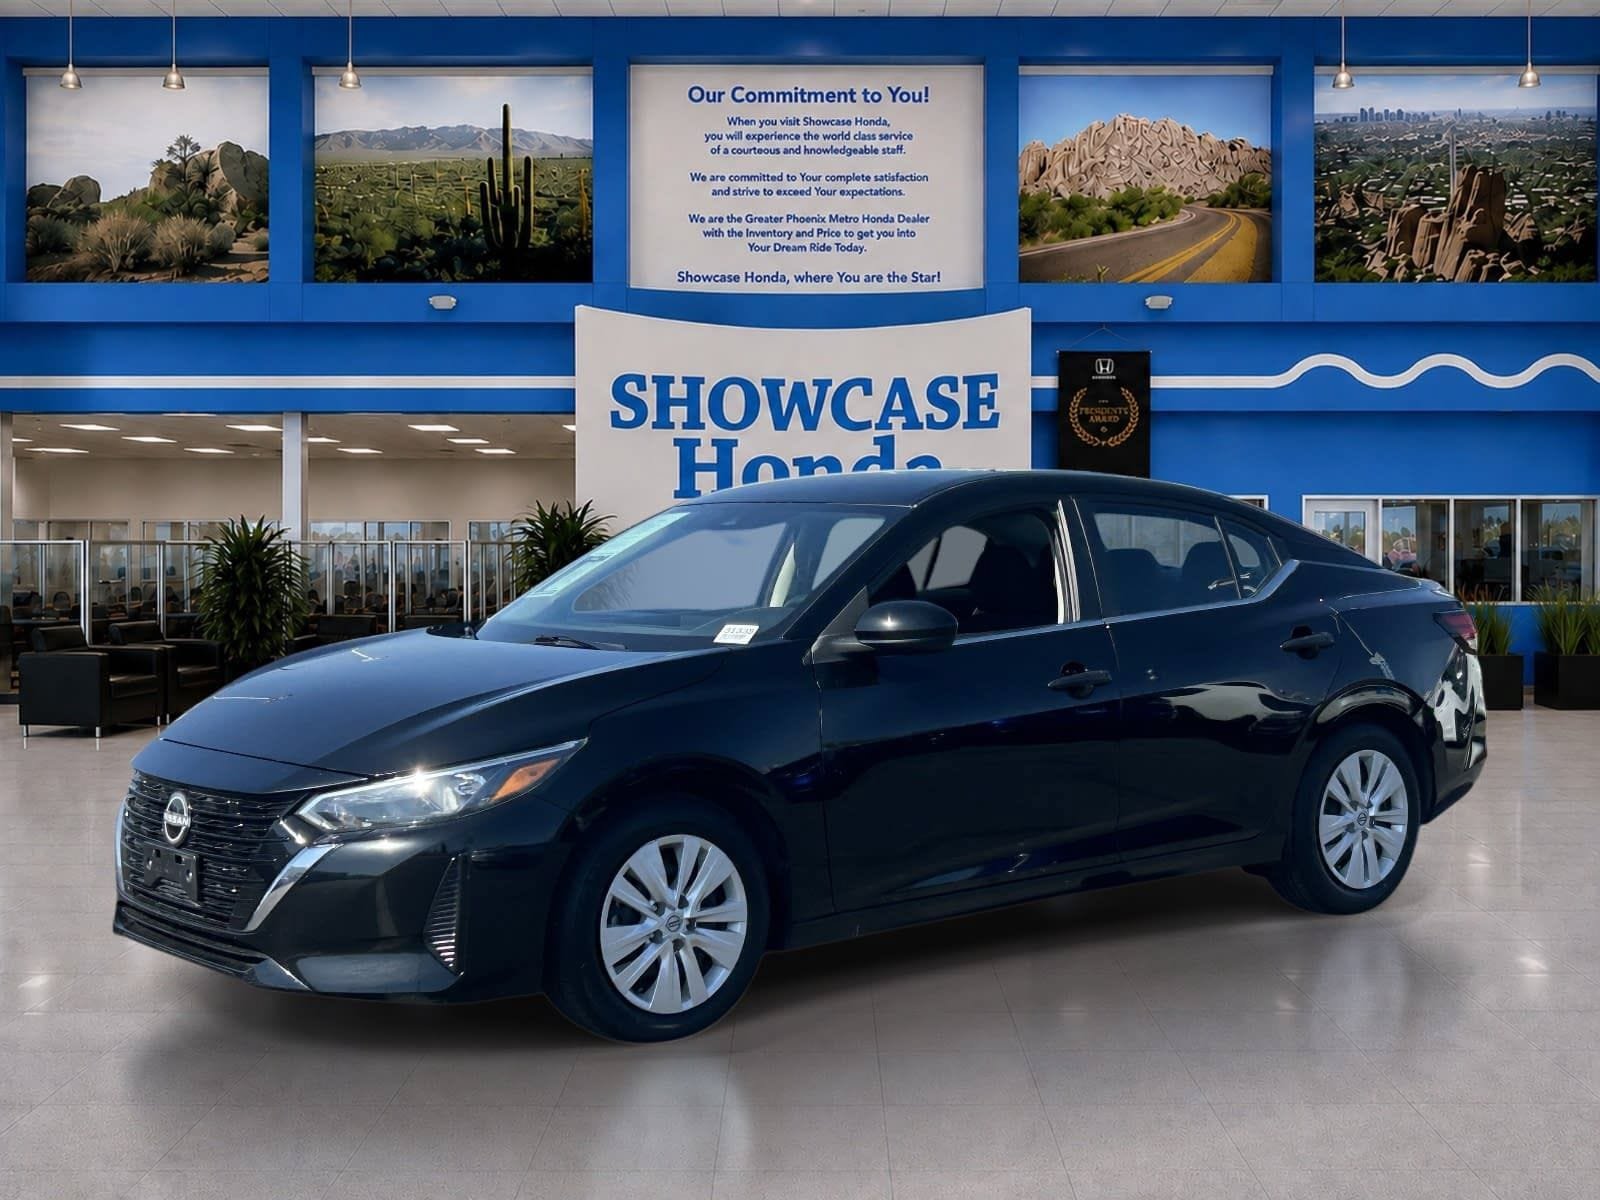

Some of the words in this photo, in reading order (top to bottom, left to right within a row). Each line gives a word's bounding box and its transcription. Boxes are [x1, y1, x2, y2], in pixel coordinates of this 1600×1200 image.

[688, 86, 725, 103] Our
[731, 86, 856, 103] Commitment
[862, 88, 882, 103] to
[887, 86, 928, 103] You!
[727, 117, 756, 126] When
[759, 119, 777, 130] you
[780, 117, 800, 126] visit
[803, 117, 852, 126] Showcase
[855, 117, 890, 127] Honda,
[705, 133, 723, 144] you
[725, 131, 742, 140] will
[746, 131, 800, 143] experience
[803, 131, 819, 140] the
[822, 131, 850, 140] world
[853, 131, 876, 140] class
[879, 131, 913, 140] service
[710, 145, 720, 154] of
[731, 147, 780, 155] courteous
[783, 145, 801, 154] and
[882, 145, 906, 154] staff.
[690, 173, 707, 182] We
[729, 172, 783, 182] committed
[787, 174, 797, 182] to
[800, 173, 822, 182] Your
[825, 173, 871, 184] complete
[874, 172, 928, 182] satisfaction
[712, 187, 730, 196] and
[733, 187, 760, 196] strive
[763, 188, 773, 196] to
[776, 187, 811, 196] exceed
[814, 187, 837, 196] Your
[840, 187, 905, 199] expectations.
[689, 214, 705, 223] We
[726, 214, 742, 223] the
[745, 214, 784, 223] Greater
[786, 214, 826, 223] Phoenix
[829, 214, 859, 223] Metro
[862, 214, 894, 223] Honda
[898, 214, 930, 223] Dealer
[703, 228, 724, 237] with
[727, 228, 743, 237] the
[746, 228, 793, 240] Inventory
[795, 228, 814, 237] and
[817, 228, 841, 237] Price
[857, 230, 874, 240] get
[876, 231, 894, 242] you
[897, 228, 916, 237] into
[748, 243, 771, 252] Your
[773, 243, 807, 252] Dream
[810, 243, 832, 252] Ride
[834, 243, 867, 254] Today.
[677, 271, 740, 283] Showcase
[745, 271, 789, 285] Honda,
[794, 271, 833, 283] where
[837, 272, 860, 283] You
[864, 275, 883, 283] are
[887, 271, 907, 283] the
[911, 272, 940, 283] Star!
[610, 373, 1000, 432] SHOWCASE
